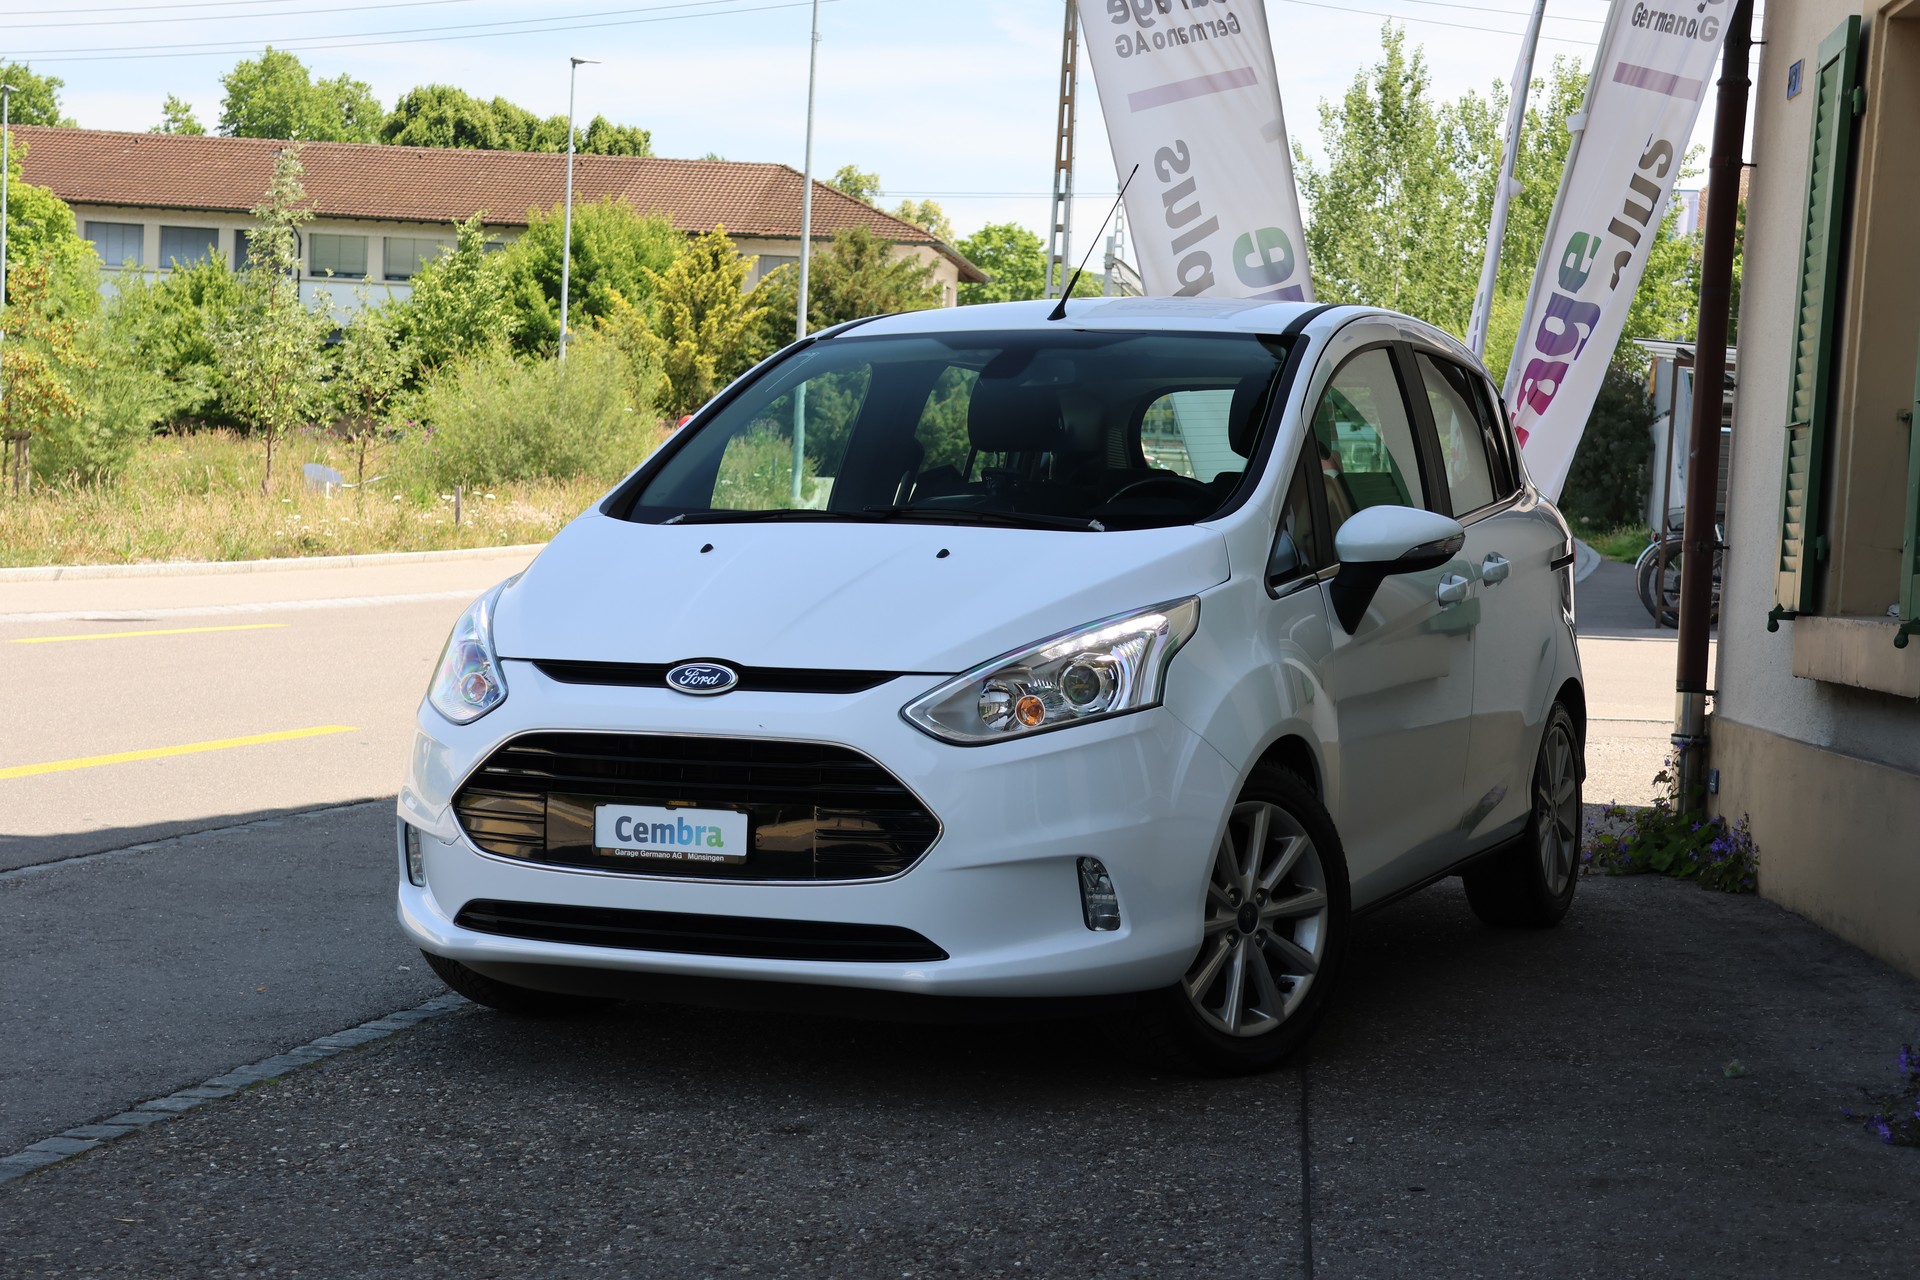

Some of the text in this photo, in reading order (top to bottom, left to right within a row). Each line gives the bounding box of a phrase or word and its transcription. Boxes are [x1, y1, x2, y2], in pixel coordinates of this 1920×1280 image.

[679, 667, 721, 686] Ford
[615, 815, 724, 848] Cembra
[614, 848, 639, 858] Garage
[640, 850, 671, 859] Germano
[687, 852, 725, 862] Münsingen
